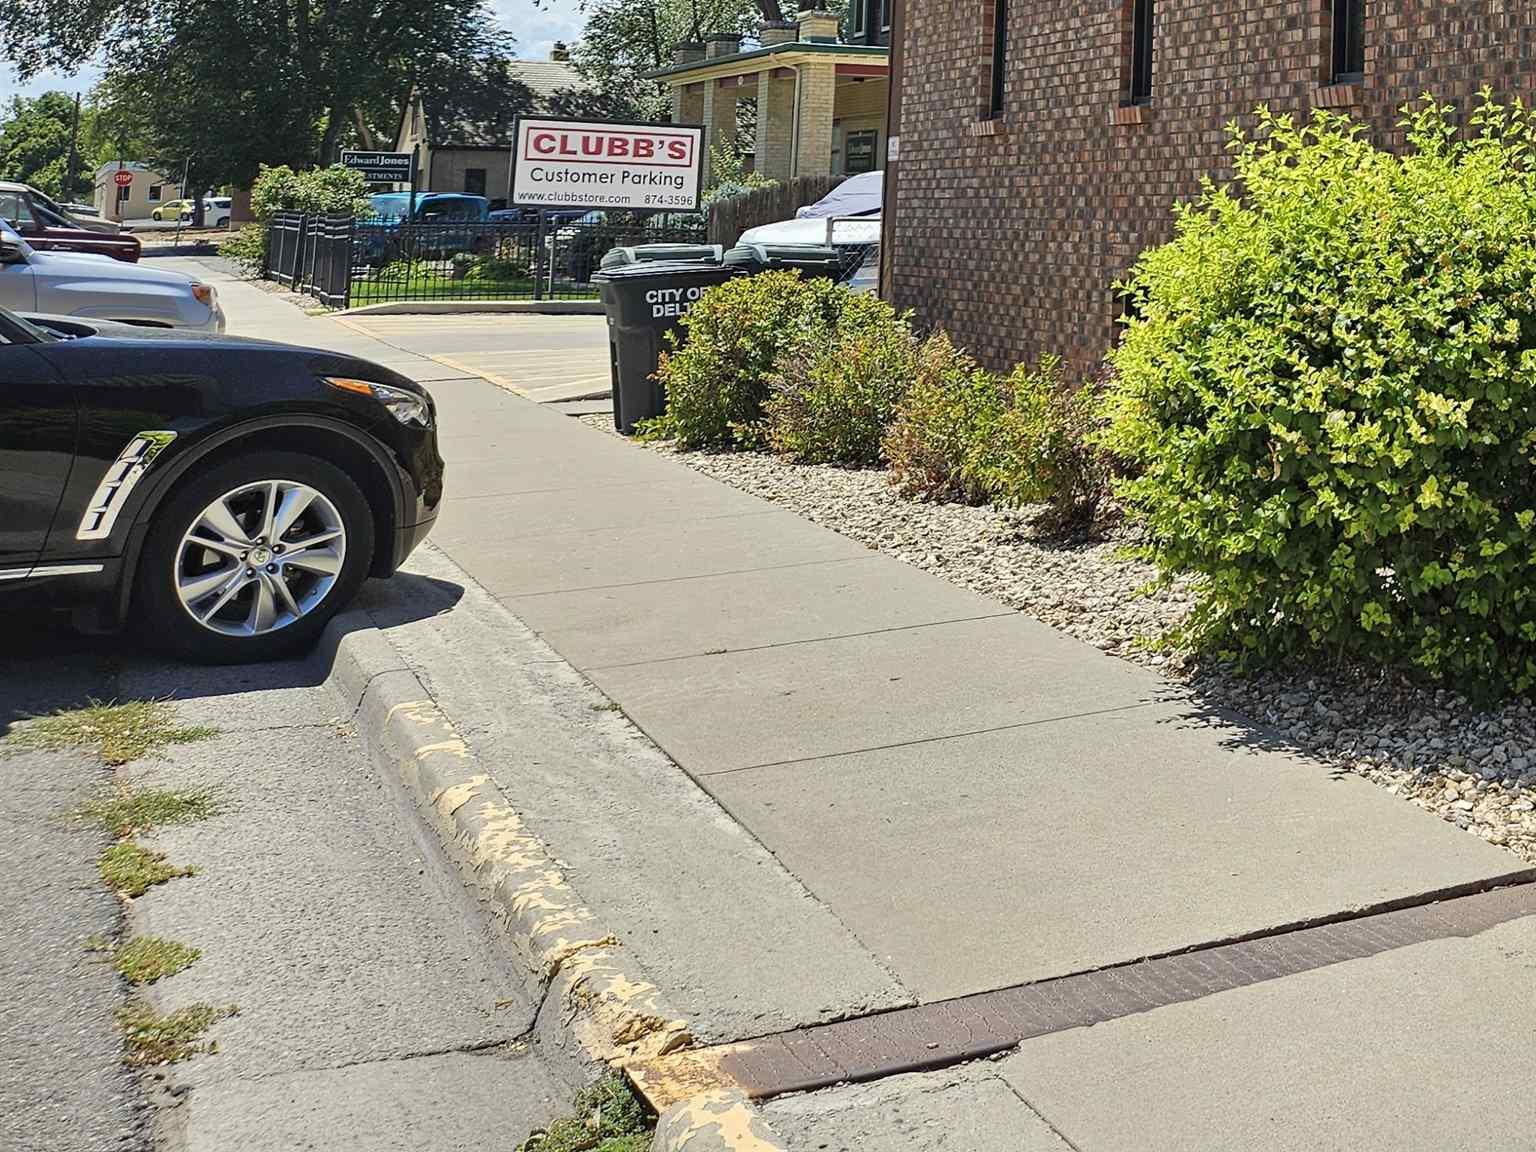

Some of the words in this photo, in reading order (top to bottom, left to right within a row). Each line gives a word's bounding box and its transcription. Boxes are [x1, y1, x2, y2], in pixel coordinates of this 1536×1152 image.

[533, 134, 687, 160] CLUBB'S
[115, 174, 132, 182] STOP
[530, 168, 615, 184] Customer
[621, 171, 684, 190] Parking
[518, 192, 631, 204] www.clubbstore.com
[644, 194, 693, 206] 874-3596
[645, 288, 683, 304] CITY
[652, 302, 692, 318] DELT
